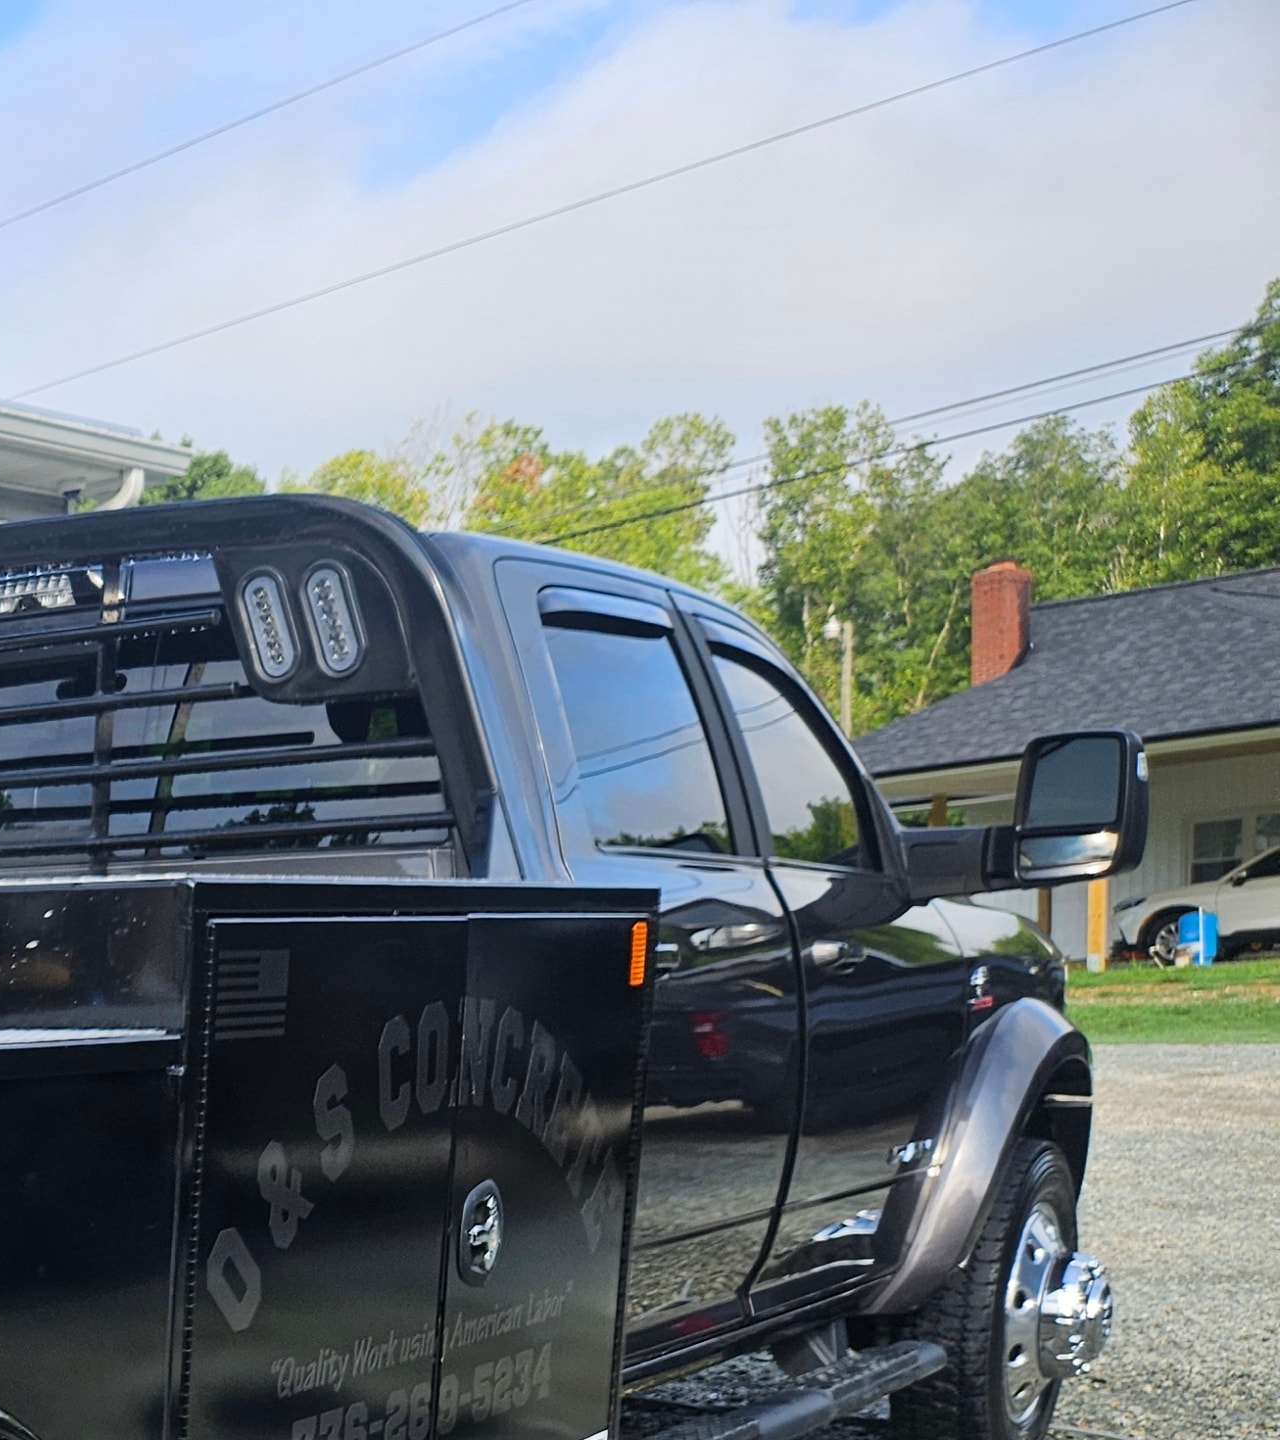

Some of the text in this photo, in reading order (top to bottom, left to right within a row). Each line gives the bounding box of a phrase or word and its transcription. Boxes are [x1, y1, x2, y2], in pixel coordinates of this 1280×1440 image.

[258, 1140, 315, 1250] &
[313, 1062, 355, 1182] S
[378, 997, 627, 1254] CONCRETE
[352, 1331, 398, 1376] Work
[450, 1304, 522, 1349] American
